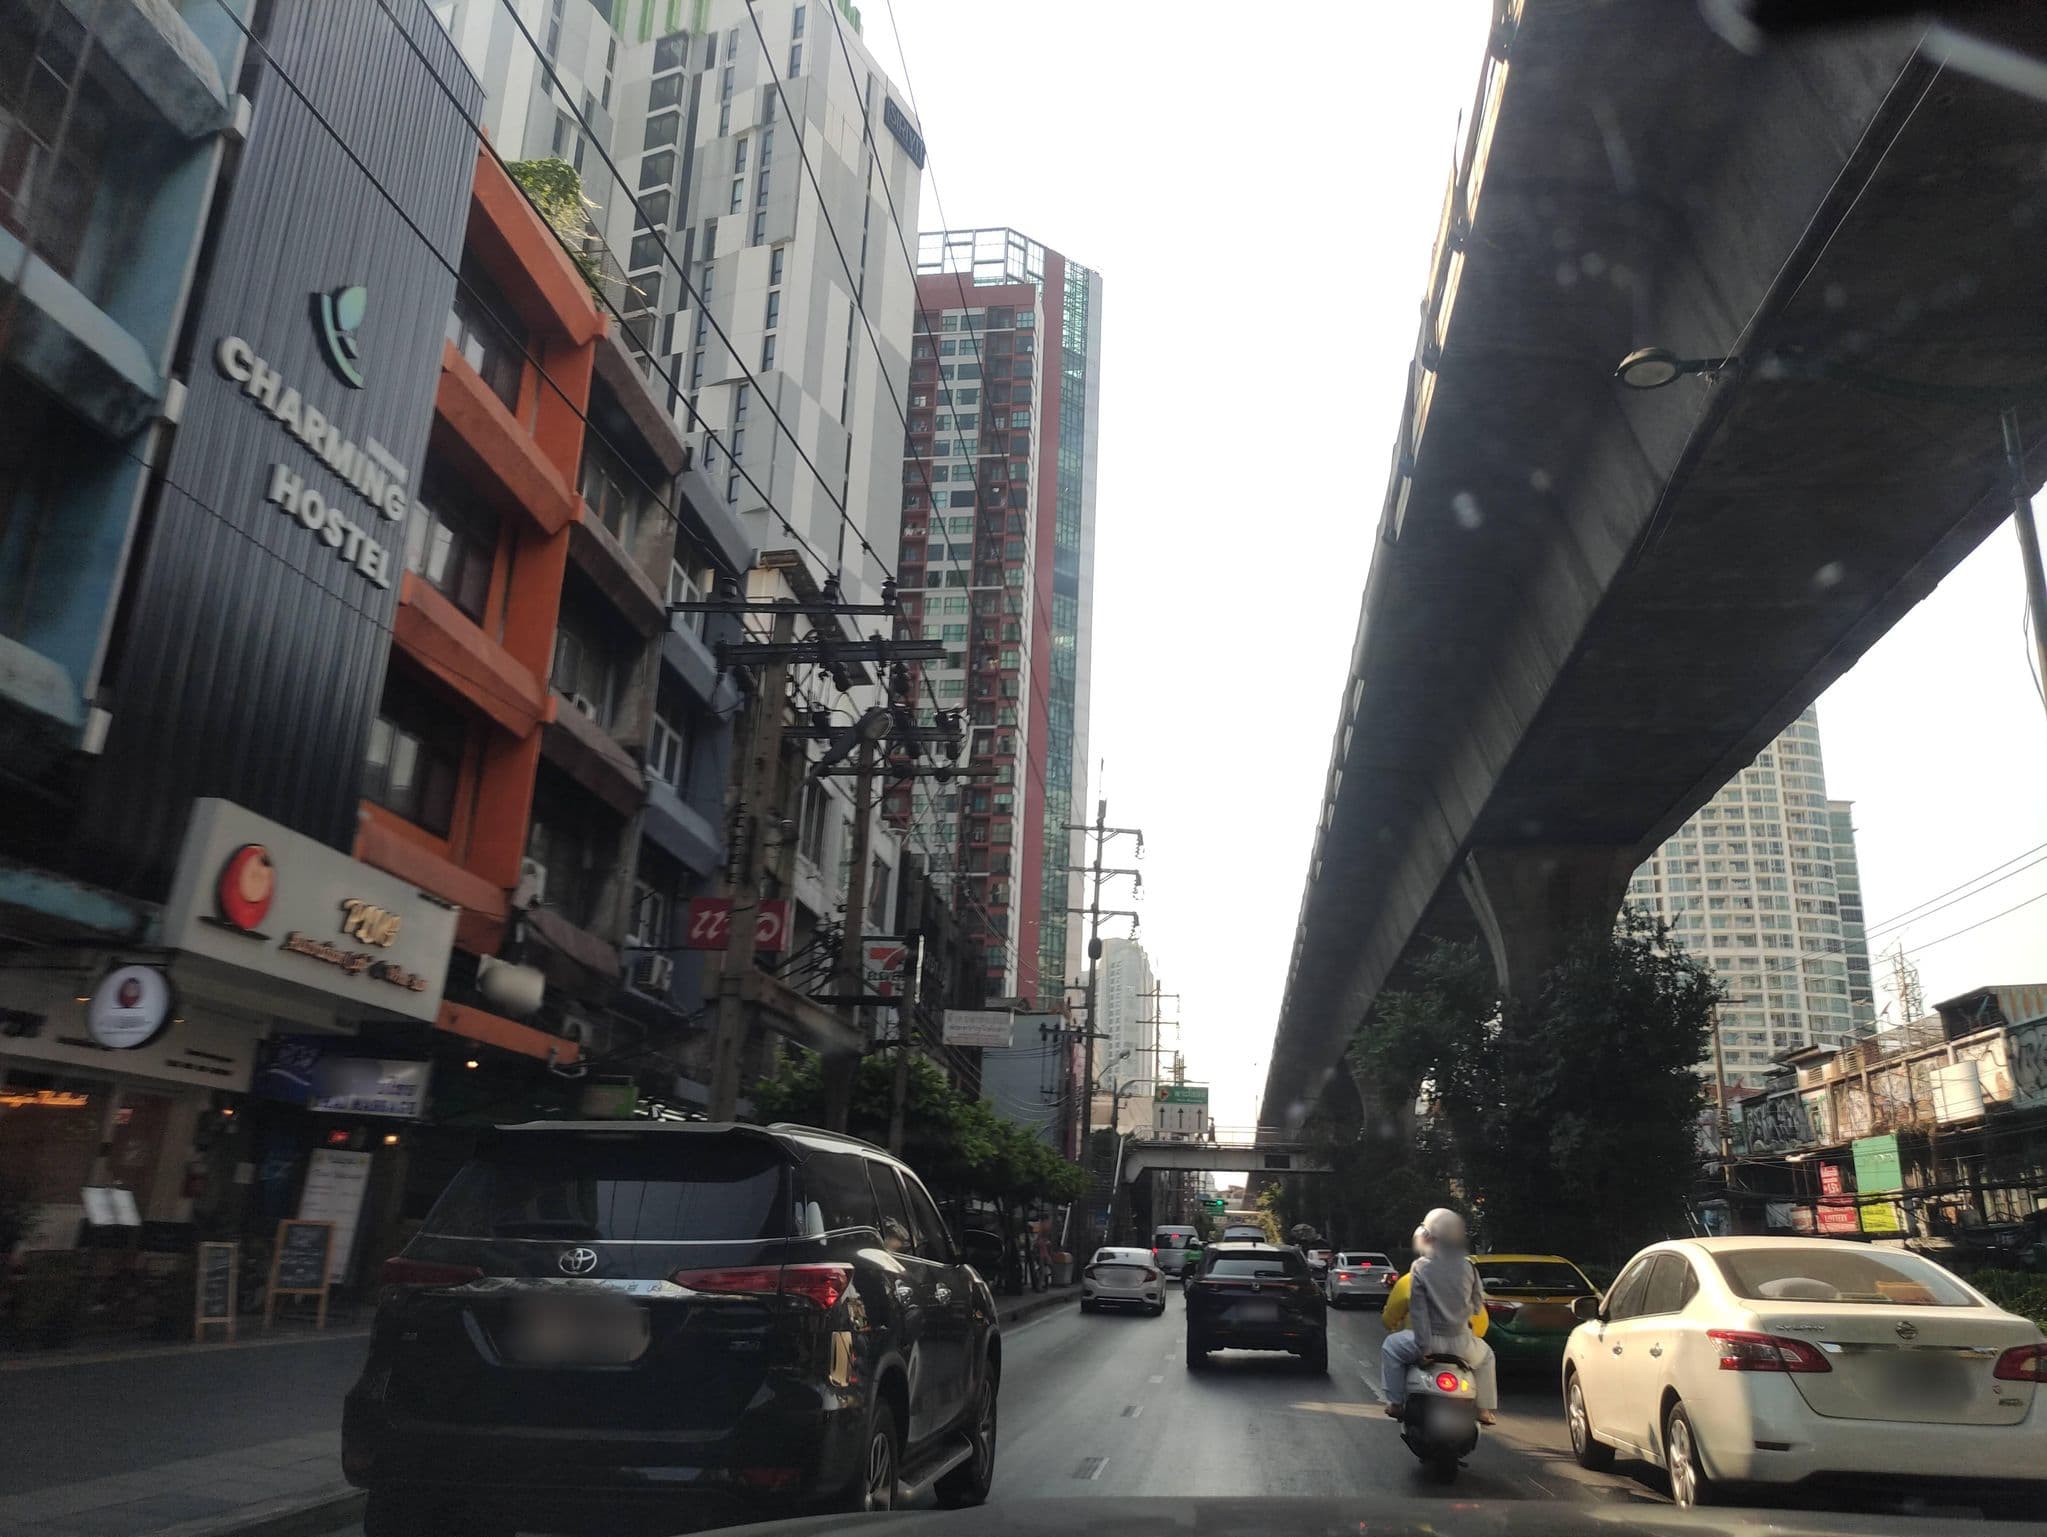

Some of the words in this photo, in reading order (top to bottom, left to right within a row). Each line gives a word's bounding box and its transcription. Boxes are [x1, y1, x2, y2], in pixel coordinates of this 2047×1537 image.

[217, 335, 407, 522] CHARMING
[267, 463, 390, 590] HOSTEL
[1823, 1212, 1848, 1223] LOTTERY
